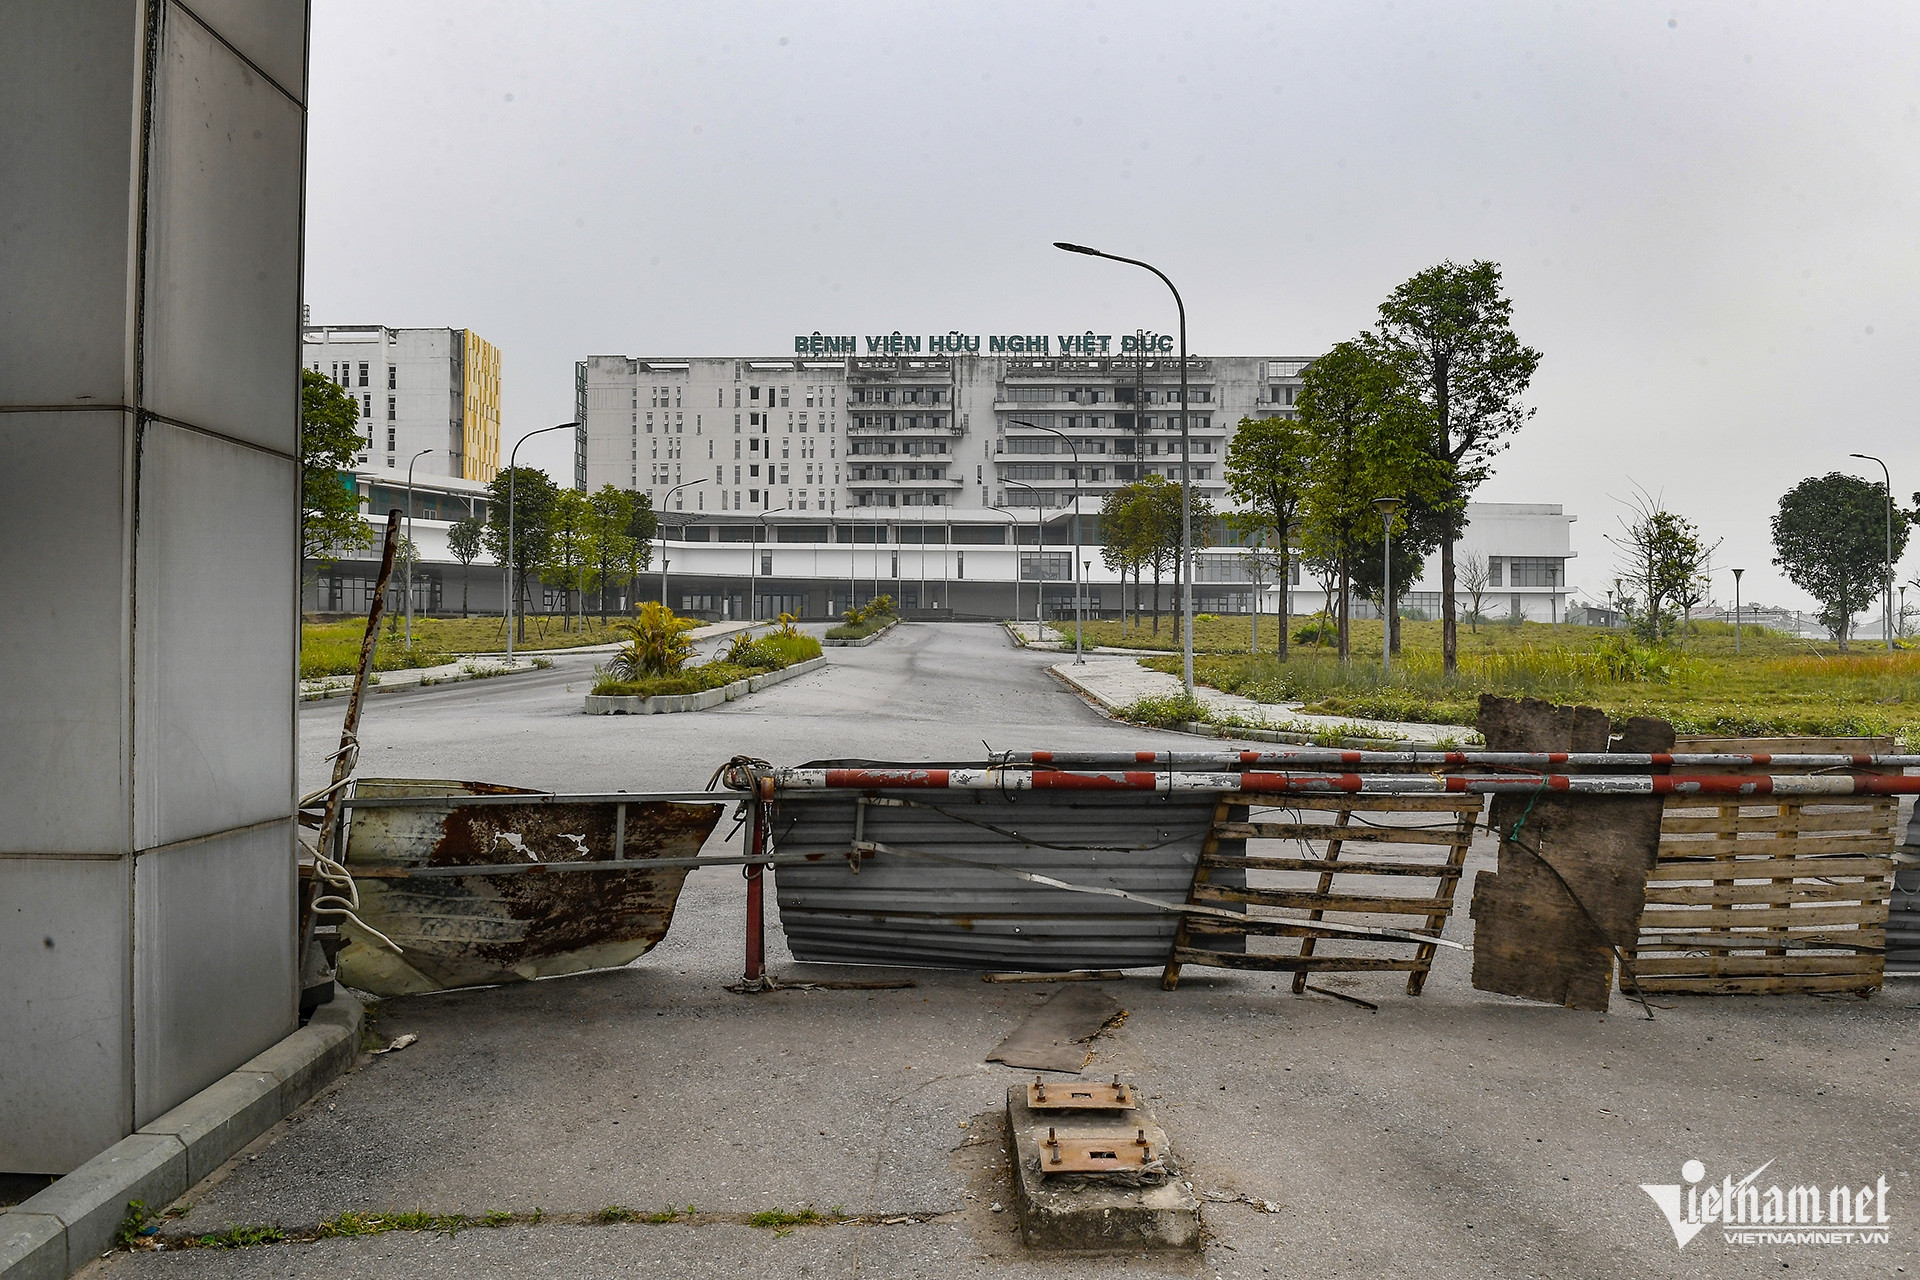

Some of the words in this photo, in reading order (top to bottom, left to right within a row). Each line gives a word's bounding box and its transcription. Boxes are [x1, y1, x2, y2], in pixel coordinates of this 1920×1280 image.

[795, 330, 857, 356] BỆNH
[865, 330, 921, 356] VIỆN
[929, 331, 981, 352] HỮU
[989, 335, 1049, 356] NGHỊ
[1057, 330, 1112, 356] VIỆT
[1121, 330, 1174, 352] ĐỨC
